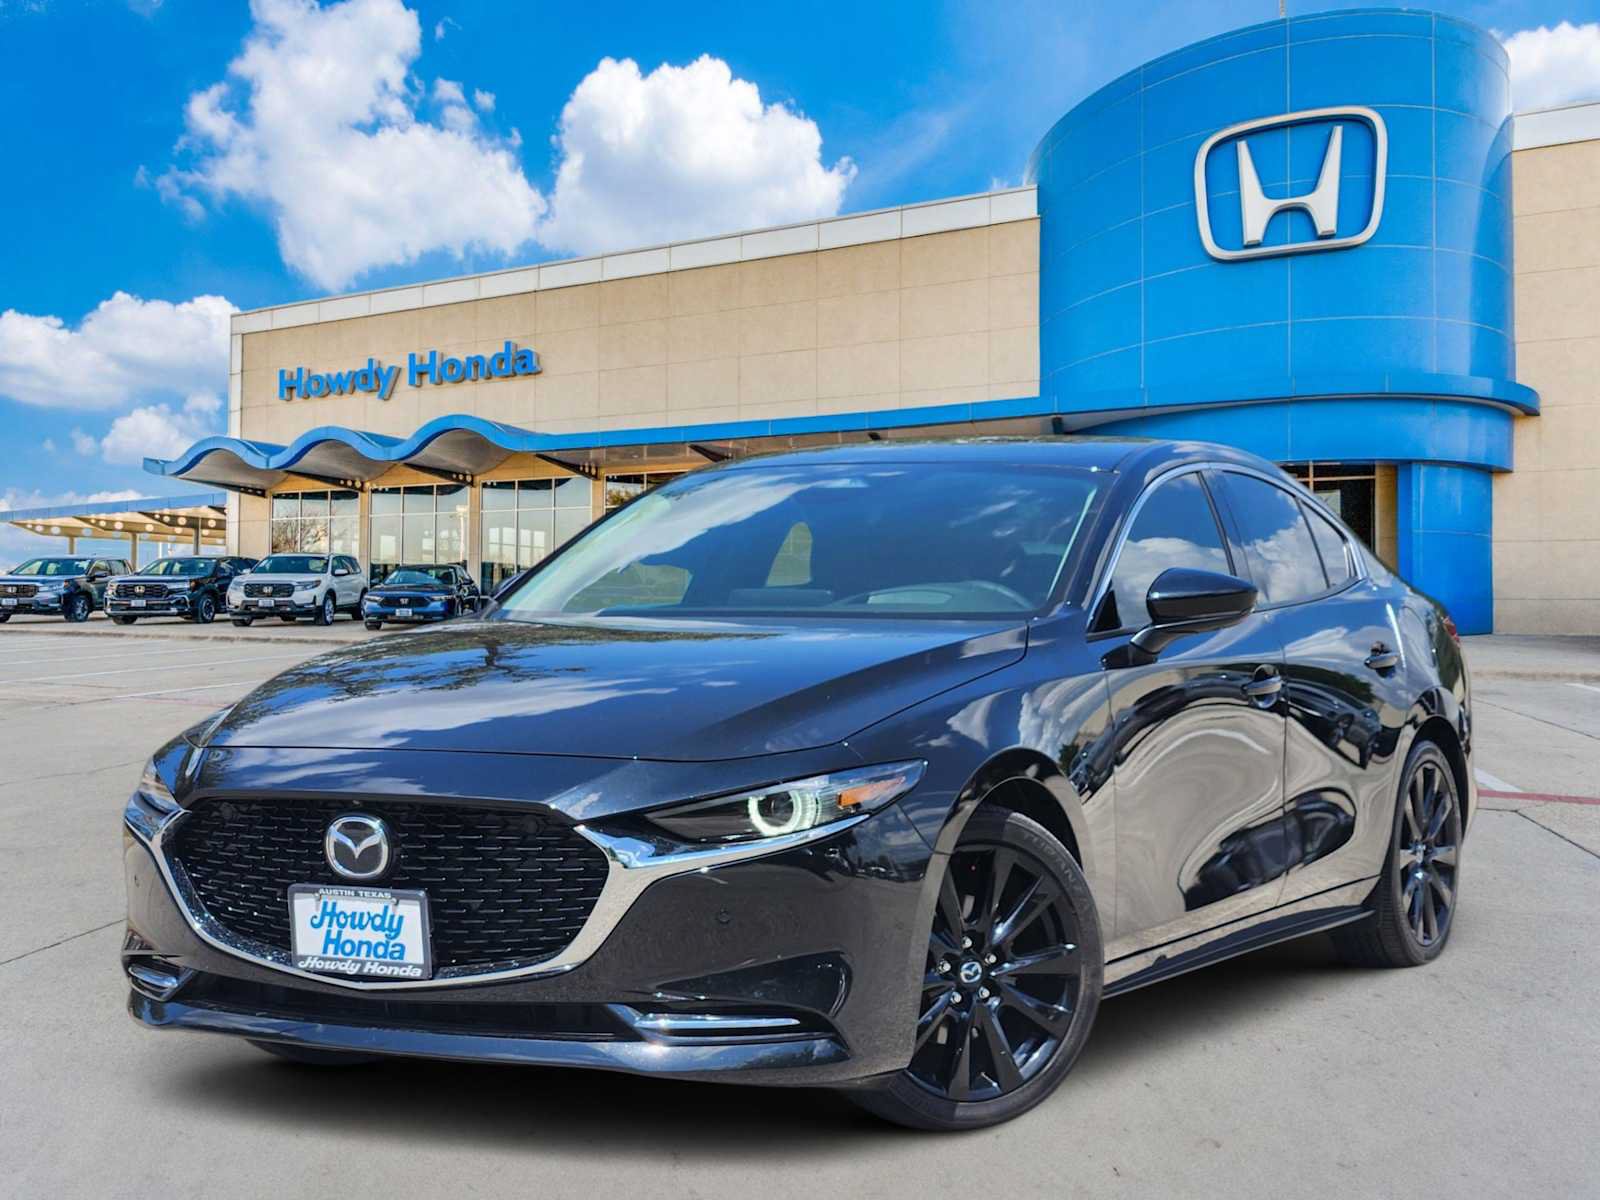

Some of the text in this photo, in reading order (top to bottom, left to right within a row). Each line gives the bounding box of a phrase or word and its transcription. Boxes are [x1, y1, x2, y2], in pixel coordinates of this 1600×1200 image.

[278, 341, 541, 401] Howdy Honda
[318, 888, 392, 899] AUSTIN TEXAS
[310, 900, 405, 940] Howdy
[322, 929, 406, 961] Honda
[298, 956, 423, 977] Howdy Honda
